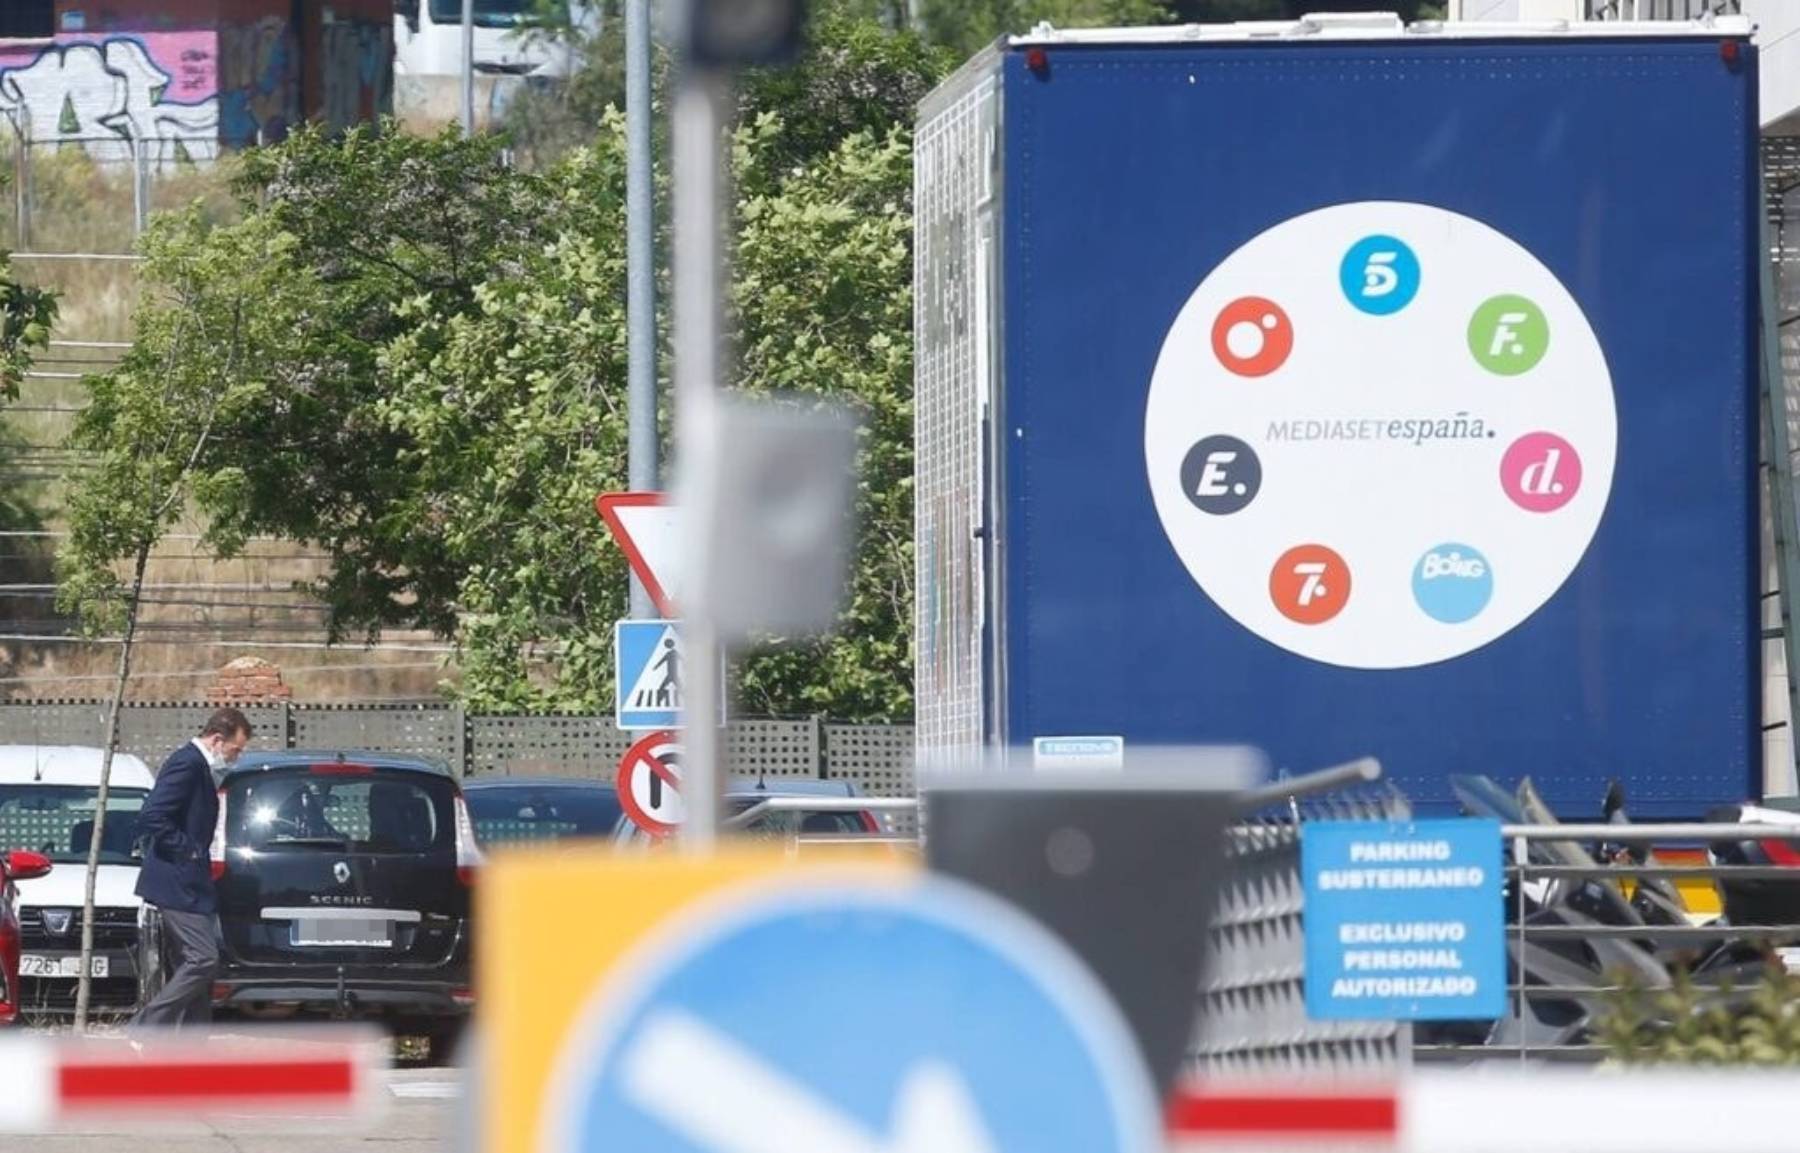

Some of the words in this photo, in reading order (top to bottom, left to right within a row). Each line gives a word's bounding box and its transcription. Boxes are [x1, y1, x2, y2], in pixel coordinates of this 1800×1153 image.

[1350, 841, 1450, 862] PARKING
[1318, 867, 1484, 890] SUBTERRANEO
[310, 895, 373, 905] SCENIC
[1339, 922, 1466, 943] EXCLUSIVO
[1343, 949, 1463, 971] PERSONAL
[1331, 975, 1478, 998] AUTORIZADO
